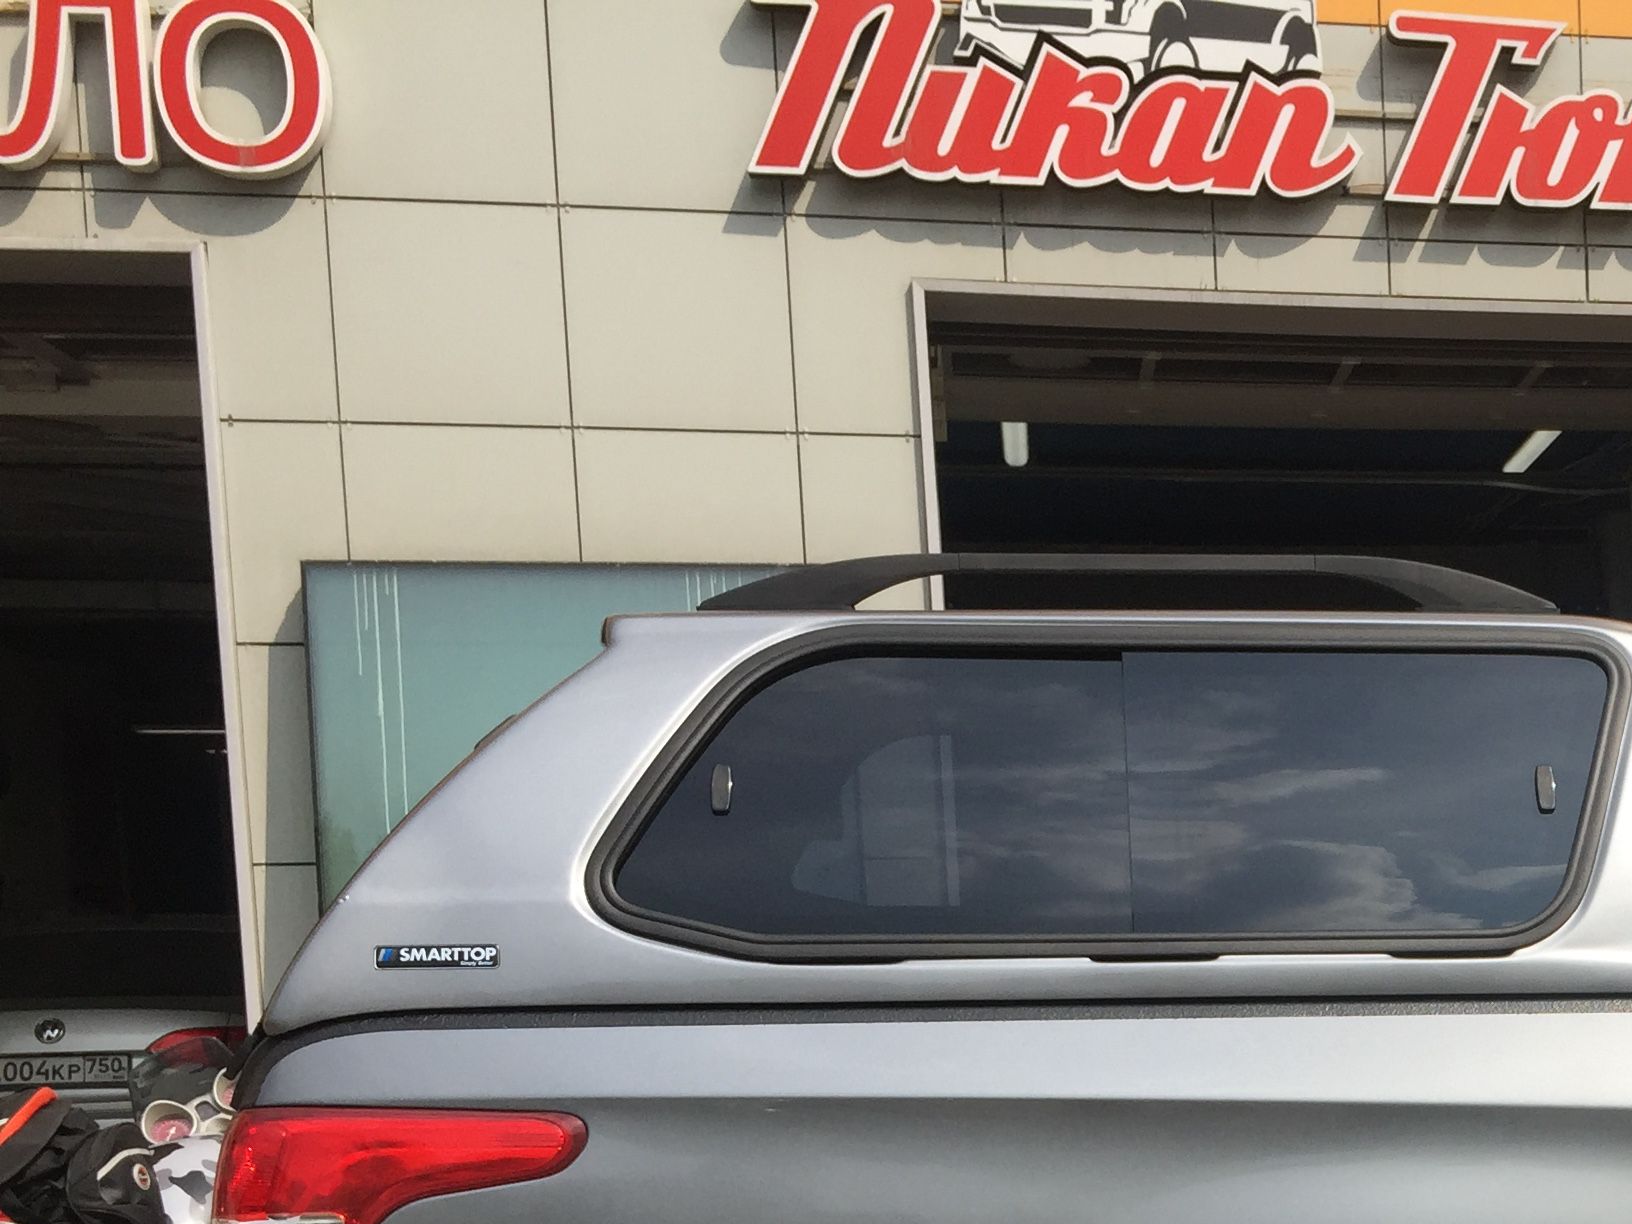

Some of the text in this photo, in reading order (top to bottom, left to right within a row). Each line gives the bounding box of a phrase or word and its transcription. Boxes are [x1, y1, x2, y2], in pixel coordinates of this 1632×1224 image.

[748, 0, 1363, 199] Пикап
[399, 947, 497, 962] SMARTTOP
[86, 1057, 123, 1074] 750
